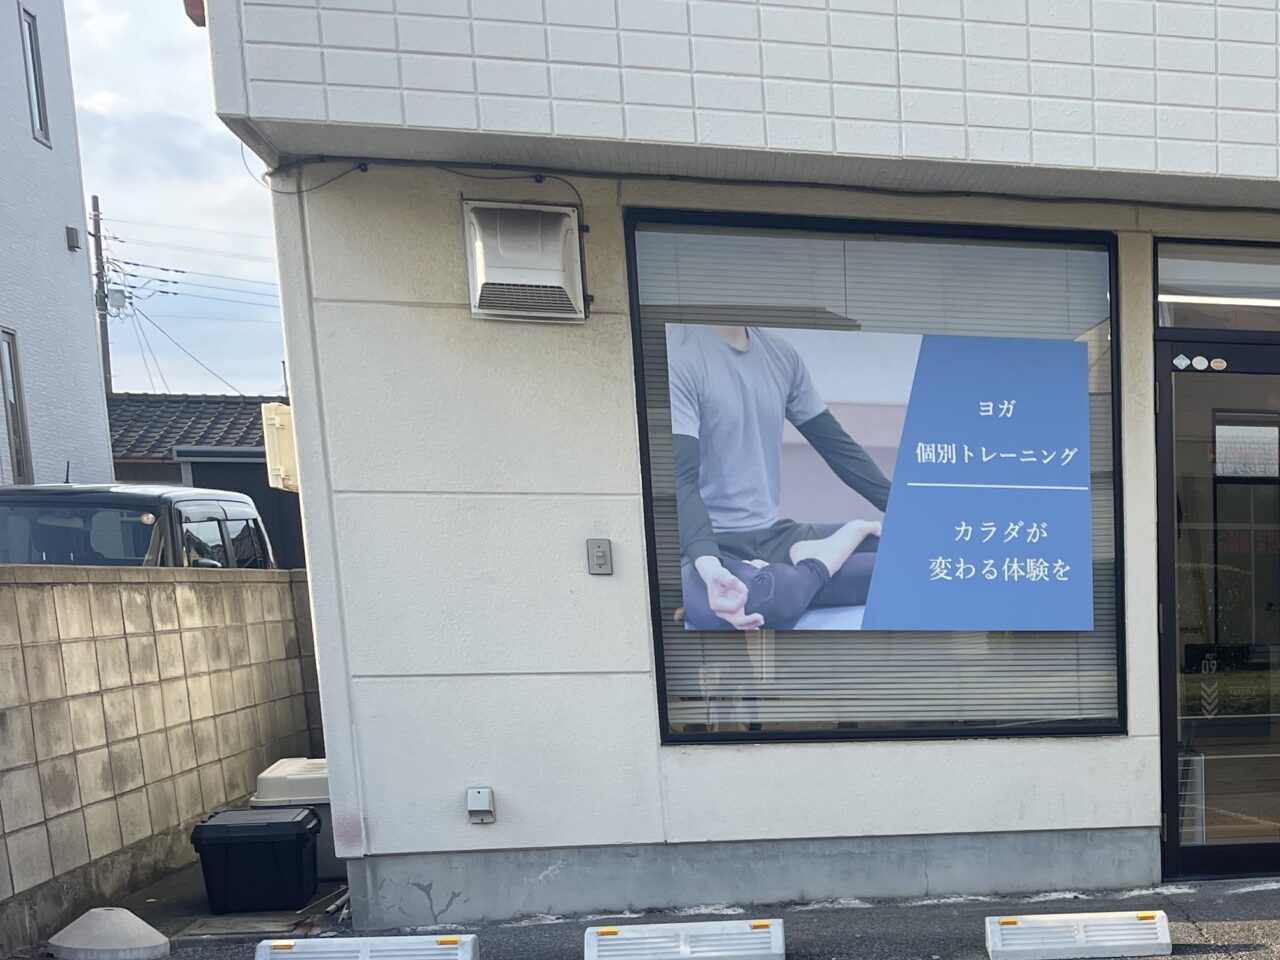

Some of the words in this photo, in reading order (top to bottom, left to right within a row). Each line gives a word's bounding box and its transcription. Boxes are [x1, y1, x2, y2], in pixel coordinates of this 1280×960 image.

[979, 399, 1016, 418] ヨガ
[916, 441, 1078, 466] 個別トレーニング
[954, 520, 1048, 543] カラダが
[929, 556, 1071, 581] 変わる体験を
